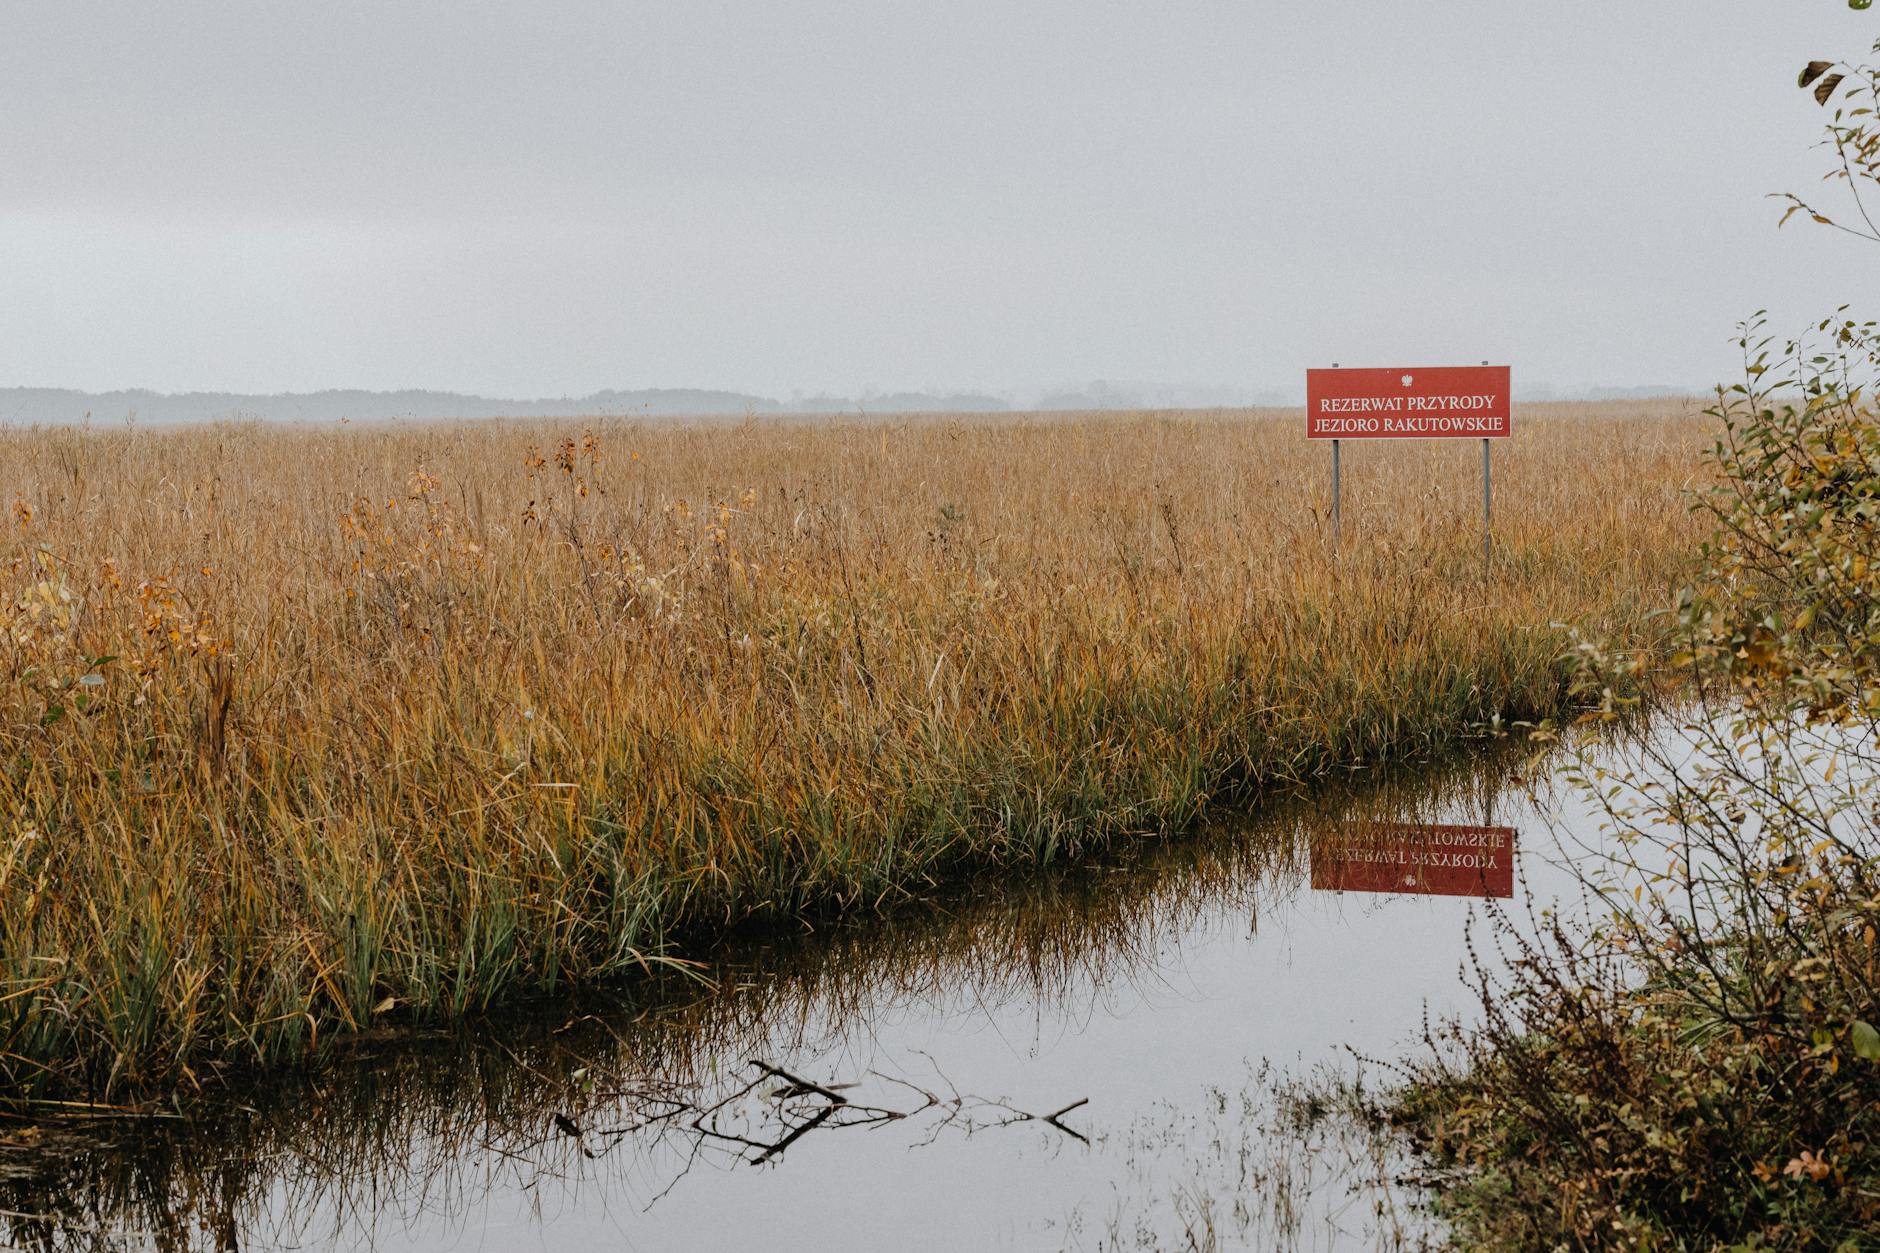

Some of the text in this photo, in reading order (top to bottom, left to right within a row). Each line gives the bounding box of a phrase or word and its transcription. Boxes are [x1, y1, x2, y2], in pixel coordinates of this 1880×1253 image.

[1321, 395, 1496, 412] REZERWAT PRZYRODY
[1314, 417, 1504, 433] JEZIORO RAKUTOWSKIE
